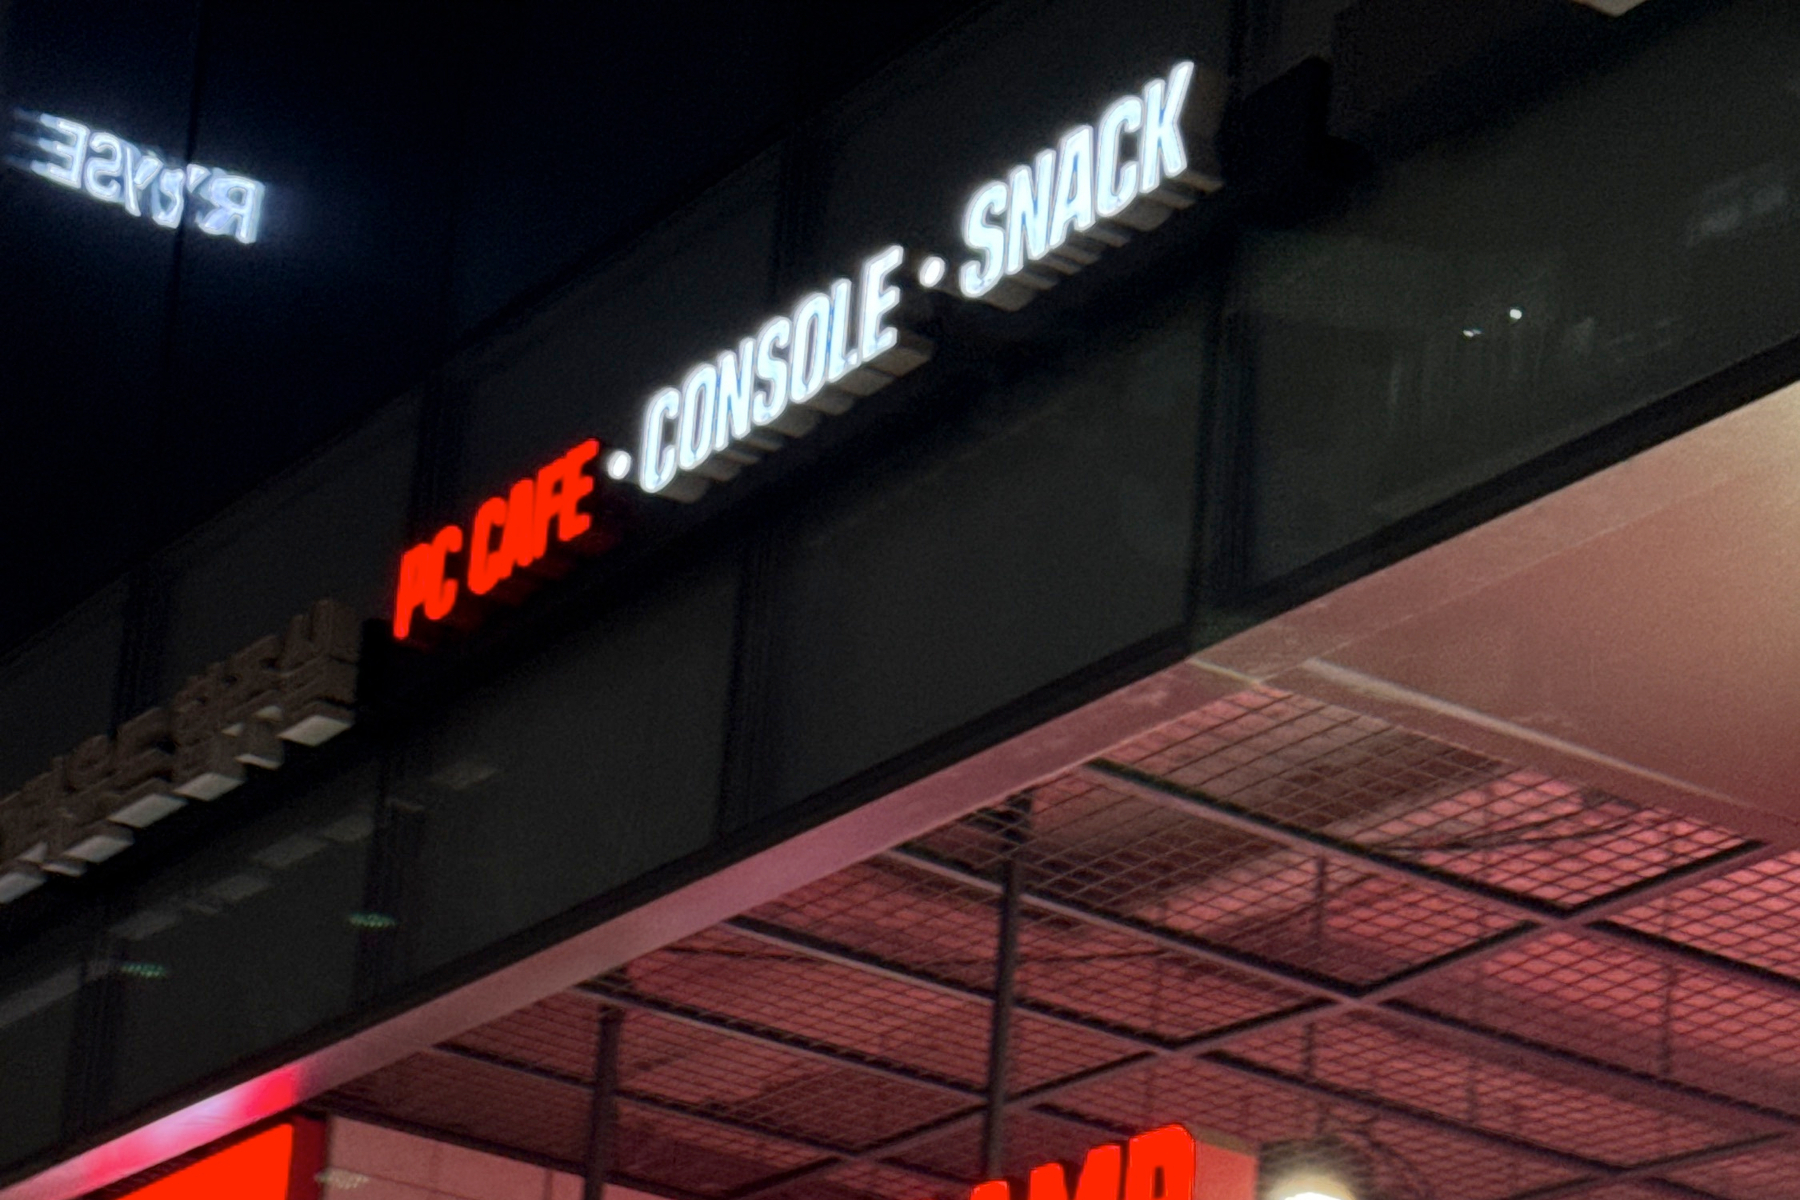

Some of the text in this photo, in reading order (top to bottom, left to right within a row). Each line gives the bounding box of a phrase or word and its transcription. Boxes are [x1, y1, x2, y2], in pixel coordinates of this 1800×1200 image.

[393, 60, 1195, 640] PC CAFE CONSOLE SNACK
